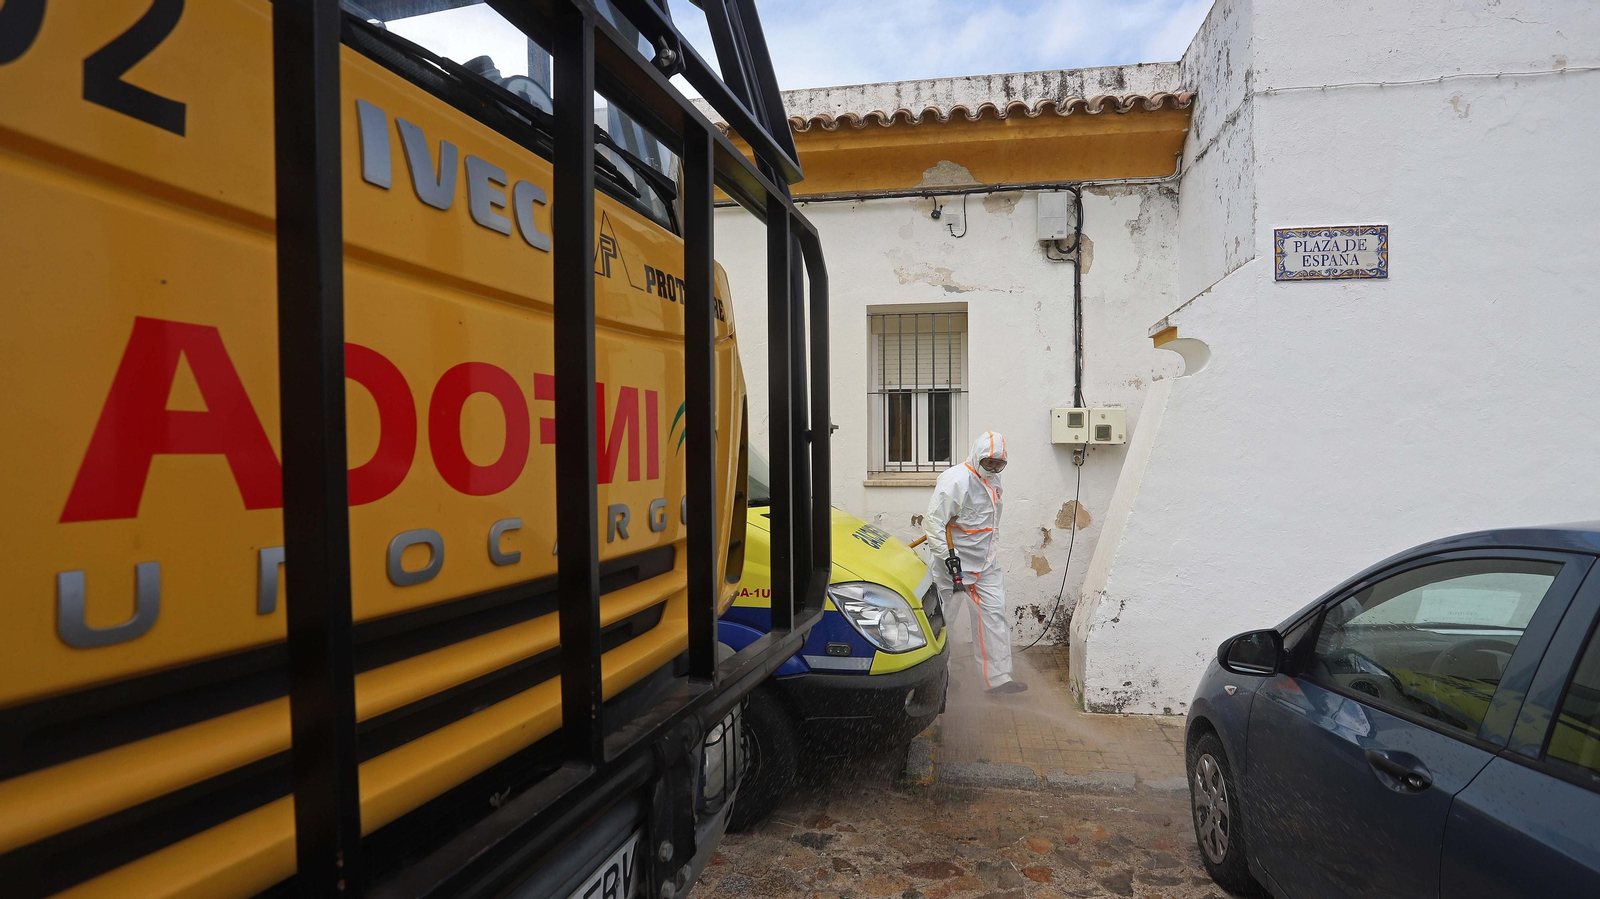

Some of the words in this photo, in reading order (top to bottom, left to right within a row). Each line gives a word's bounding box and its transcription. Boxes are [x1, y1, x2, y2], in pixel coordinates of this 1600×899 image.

[356, 98, 554, 253] IVEC
[1293, 239, 1340, 253] PLAZA
[1344, 238, 1367, 252] DE
[1302, 251, 1360, 267] ESPAÑA
